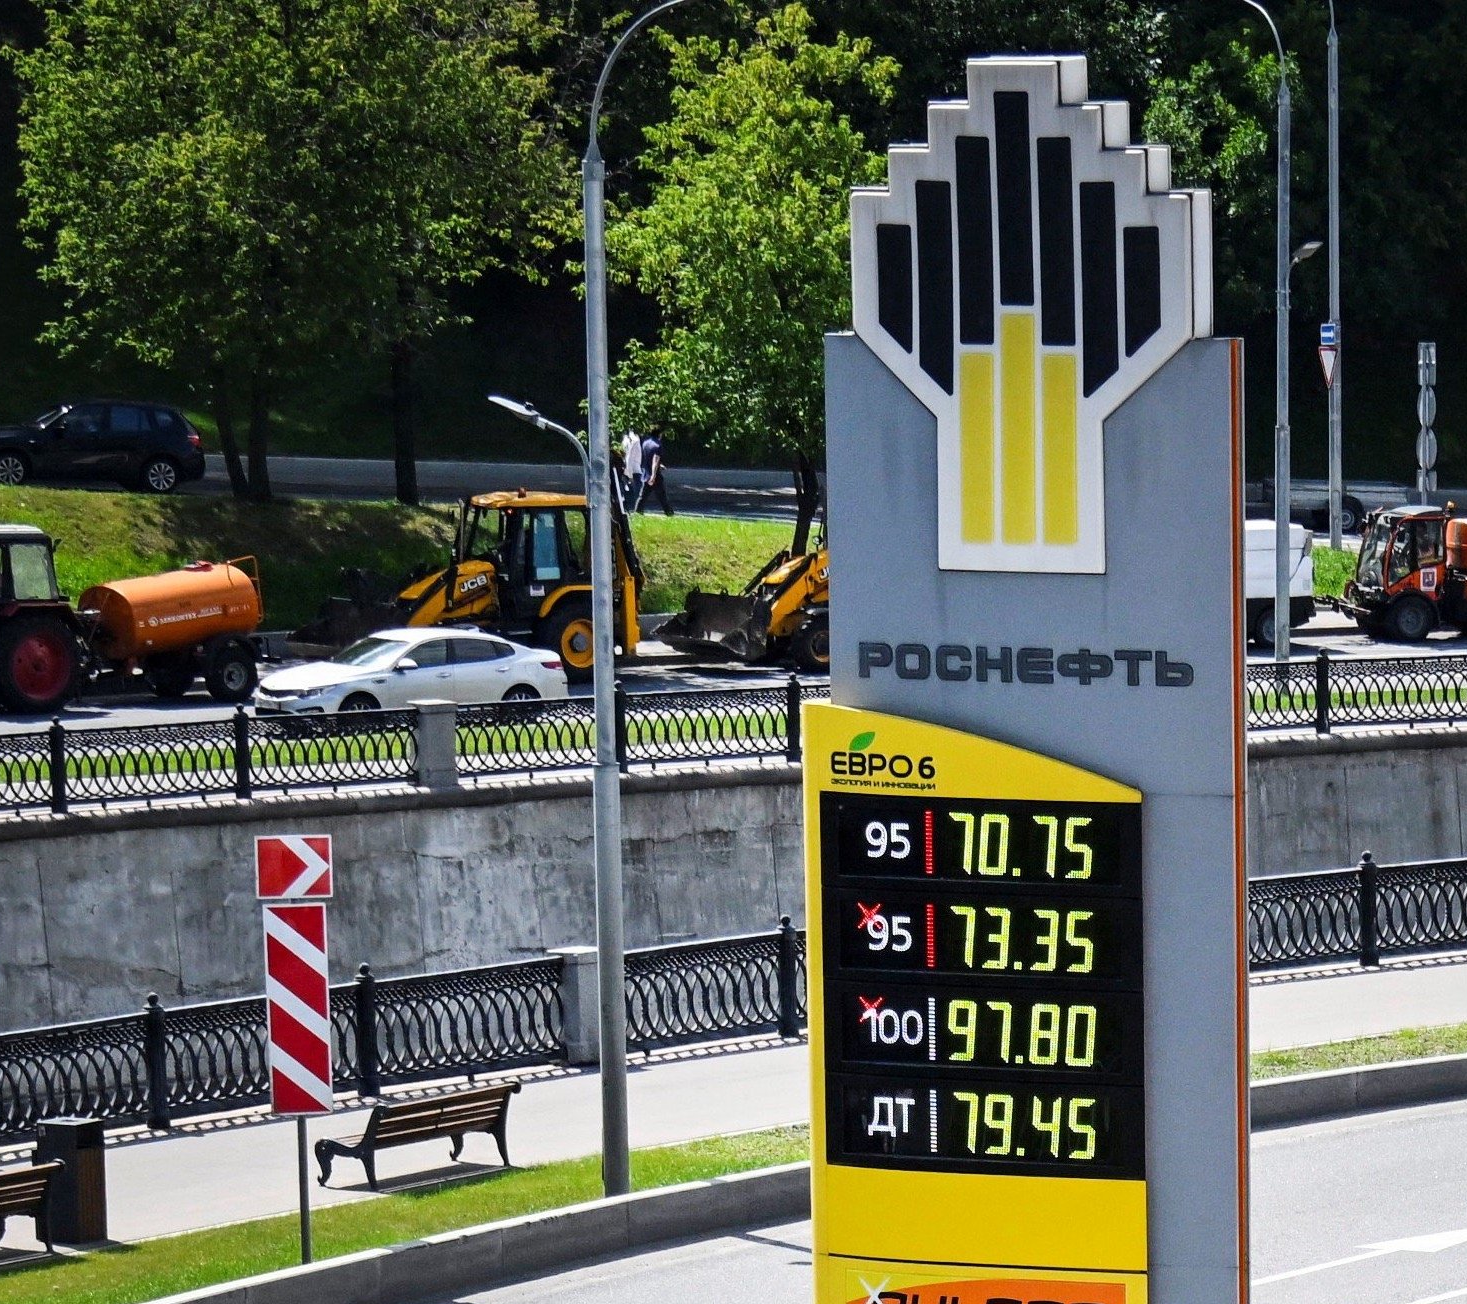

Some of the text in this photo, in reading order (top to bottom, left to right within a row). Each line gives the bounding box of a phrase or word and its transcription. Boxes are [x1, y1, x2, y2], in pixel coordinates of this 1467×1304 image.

[460, 574, 488, 592] JCB
[858, 641, 1194, 687] РОСНЕФТЬ
[831, 751, 936, 780] ЕВРО 6
[865, 812, 1094, 879] 95 70.75
[866, 905, 1095, 973] 95 73.35
[864, 1000, 1098, 1067] 100 97.80
[867, 1091, 1097, 1160] ДТ 79.45
